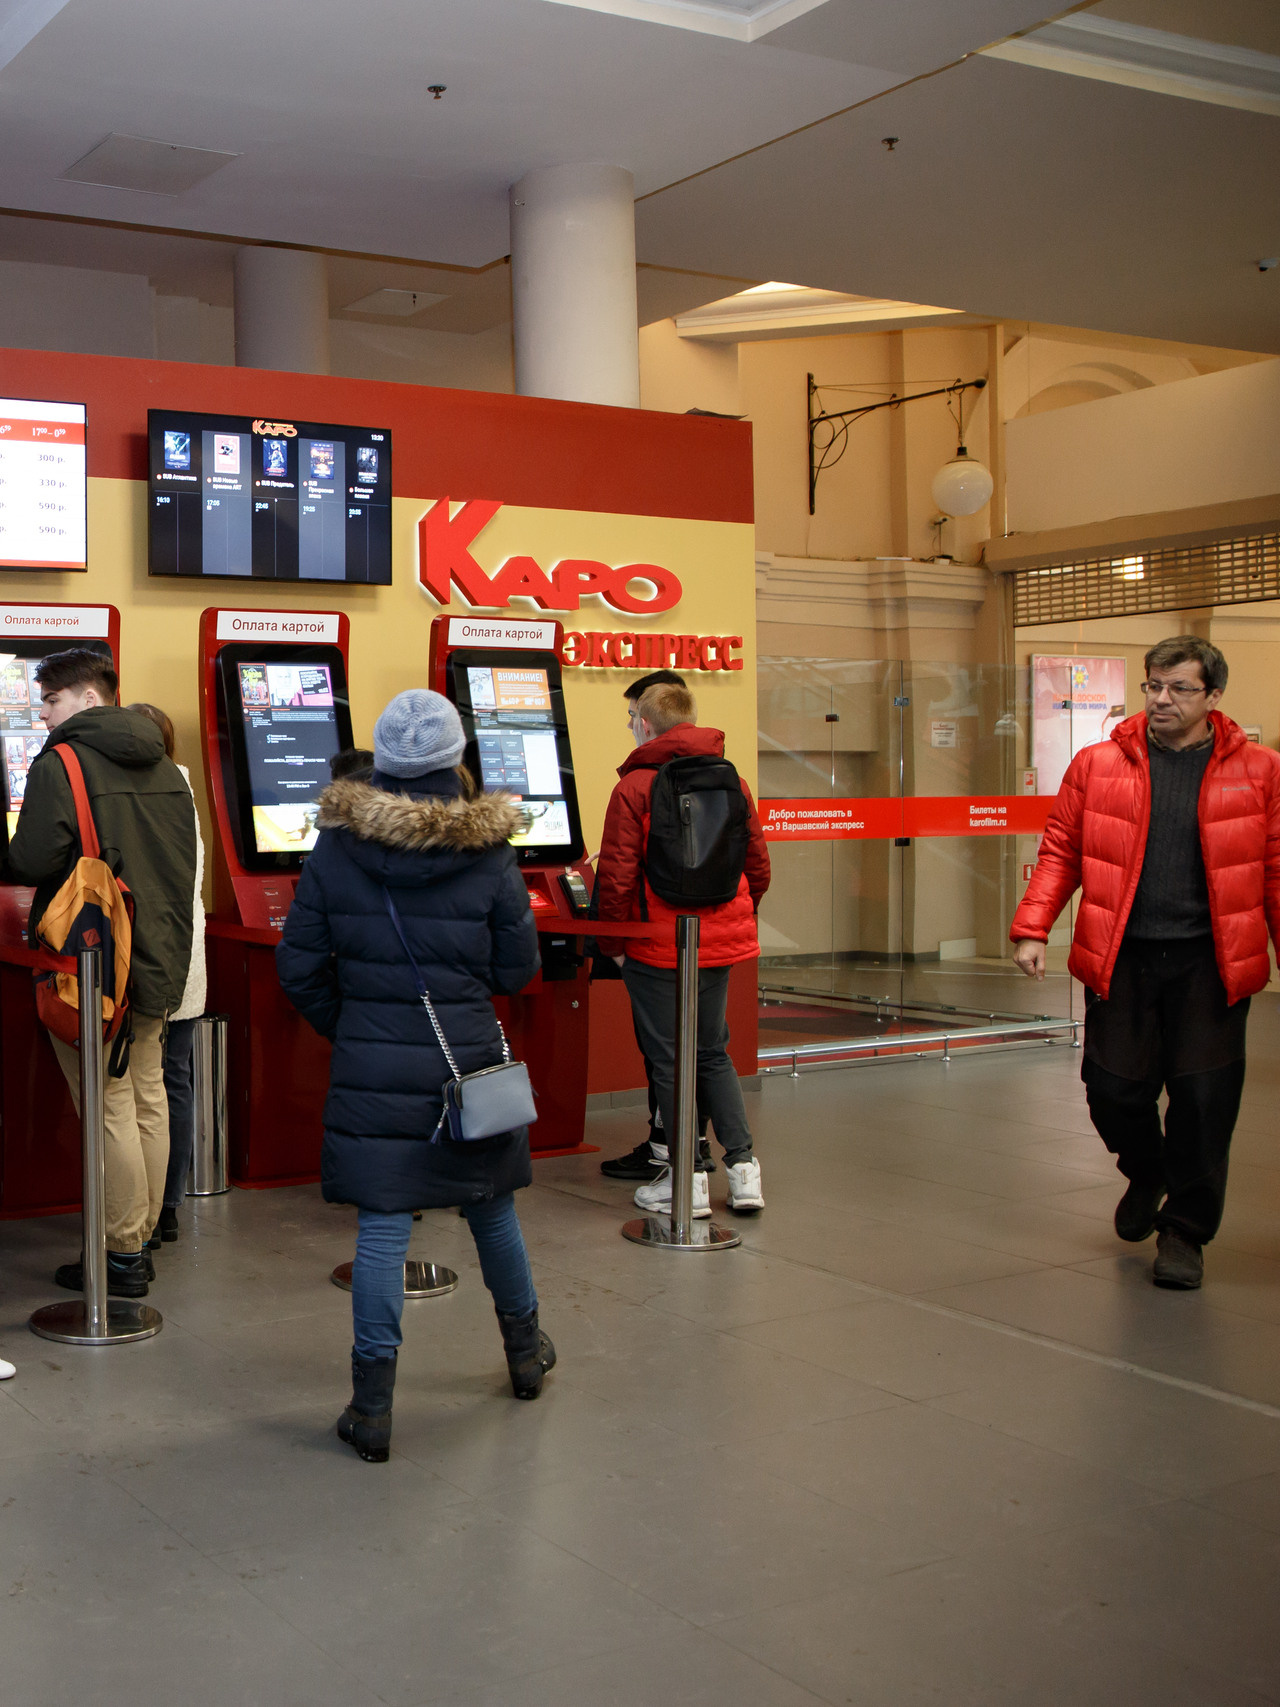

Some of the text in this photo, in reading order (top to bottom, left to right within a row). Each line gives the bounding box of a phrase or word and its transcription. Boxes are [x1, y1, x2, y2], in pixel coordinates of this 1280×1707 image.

[38, 454, 55, 462] 300
[40, 479, 56, 487] 330
[38, 502, 56, 511] 590
[38, 525, 56, 534] 590
[418, 495, 682, 614] КАРО
[4, 615, 80, 627] Оплата картой
[232, 618, 325, 634] Оплата картой
[462, 625, 543, 641] Оплата картой
[562, 631, 744, 671] ЭКСПРЕСС
[497, 672, 543, 682] ВНИМАНИЕ!
[768, 809, 796, 820] Добро
[797, 809, 846, 818] пожаловать
[970, 805, 1007, 815] Билеты на
[775, 823, 781, 831] 9
[782, 821, 829, 832] Варшавский
[831, 821, 865, 831] экспресс
[969, 817, 1007, 827] karofilm.ru
